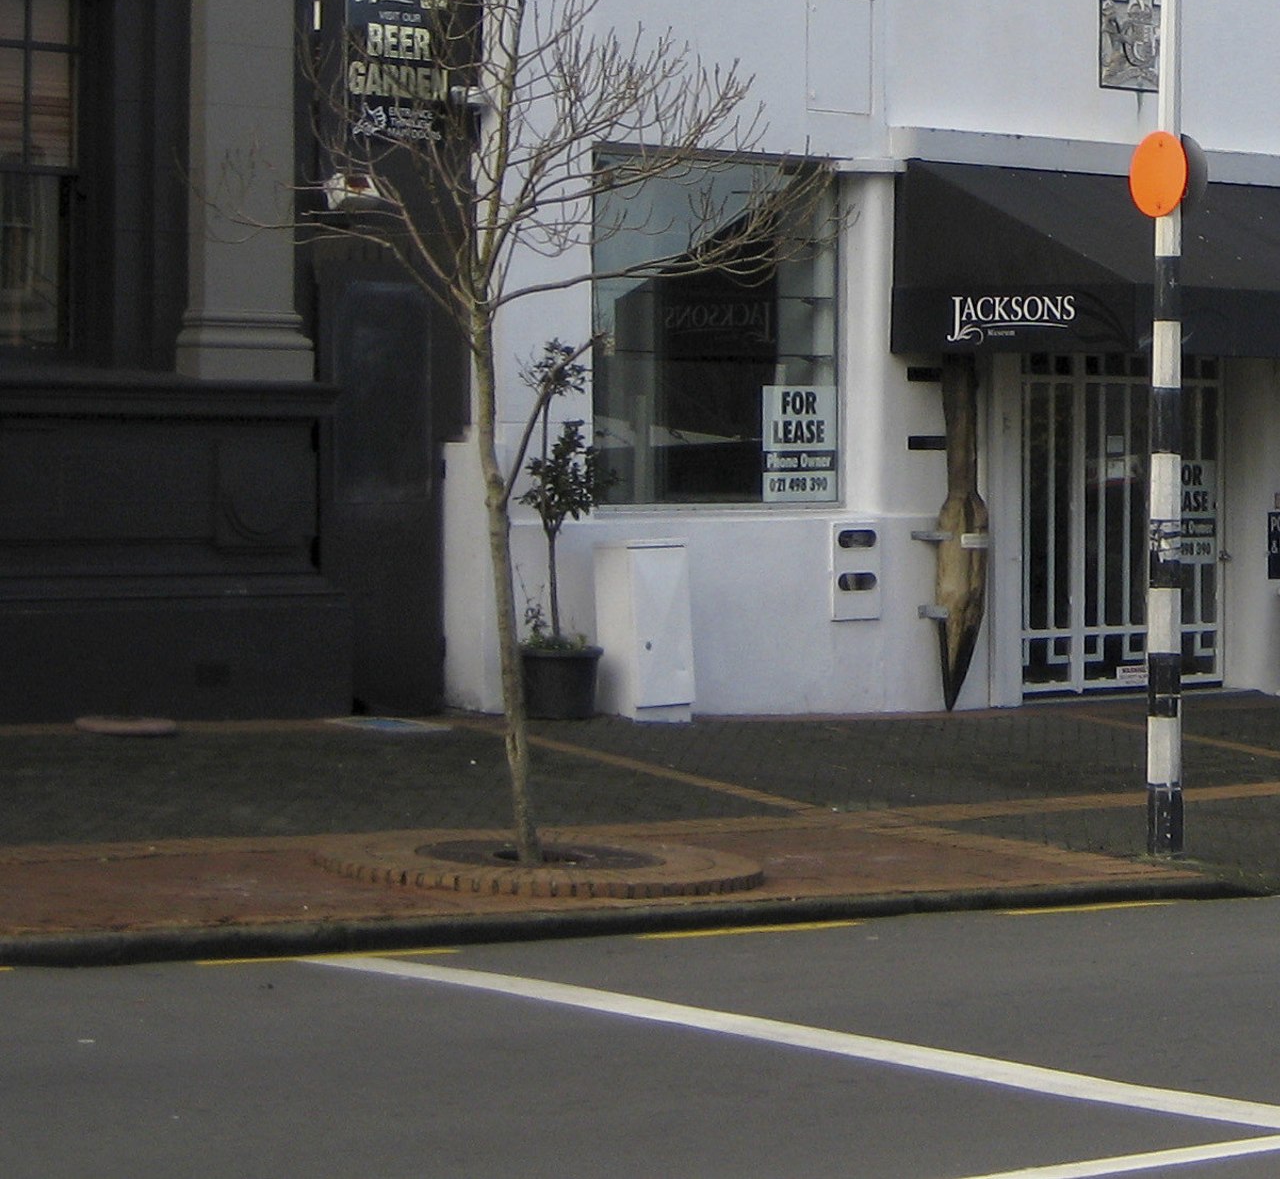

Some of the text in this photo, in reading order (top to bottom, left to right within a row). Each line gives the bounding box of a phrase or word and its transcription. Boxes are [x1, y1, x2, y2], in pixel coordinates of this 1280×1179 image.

[403, 12, 422, 23] OUR
[366, 22, 432, 61] BEER
[349, 61, 447, 101] GARDEN
[946, 295, 1076, 343] JACKSONS
[781, 390, 817, 416] FOR
[772, 419, 826, 444] LEASE
[766, 452, 832, 468] Phone Owner
[769, 477, 828, 493] 021 498 390
[1181, 464, 1202, 486] OR
[1181, 490, 1209, 512] ASE
[1271, 540, 1278, 554] &
